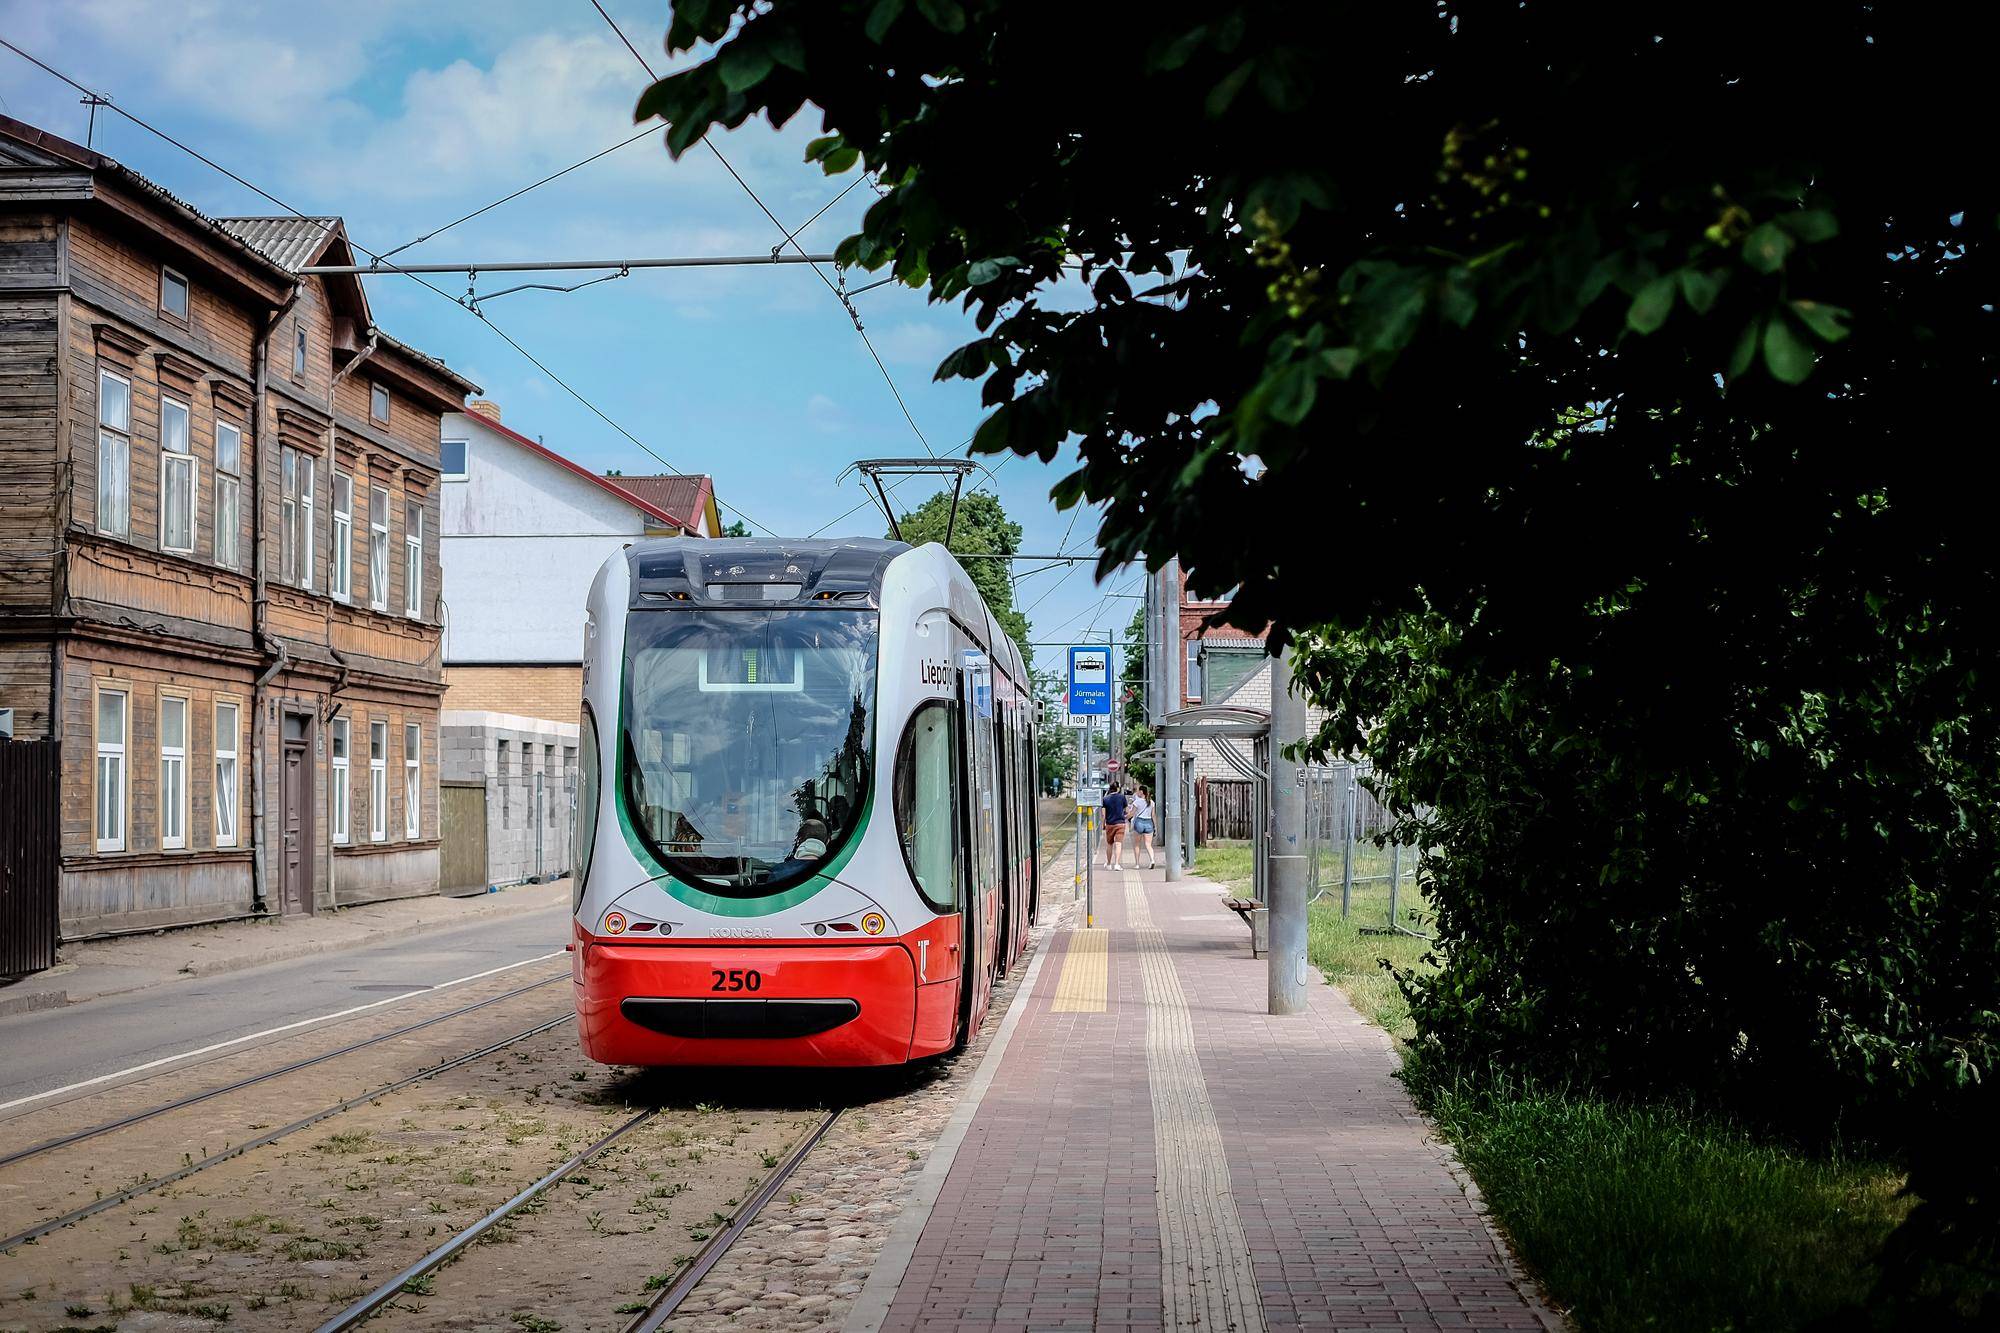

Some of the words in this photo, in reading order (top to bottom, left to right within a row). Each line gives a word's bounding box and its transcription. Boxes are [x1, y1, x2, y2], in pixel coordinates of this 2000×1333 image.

[743, 649, 757, 683] 1
[1072, 716, 1085, 724] 100
[711, 969, 762, 992] 250
